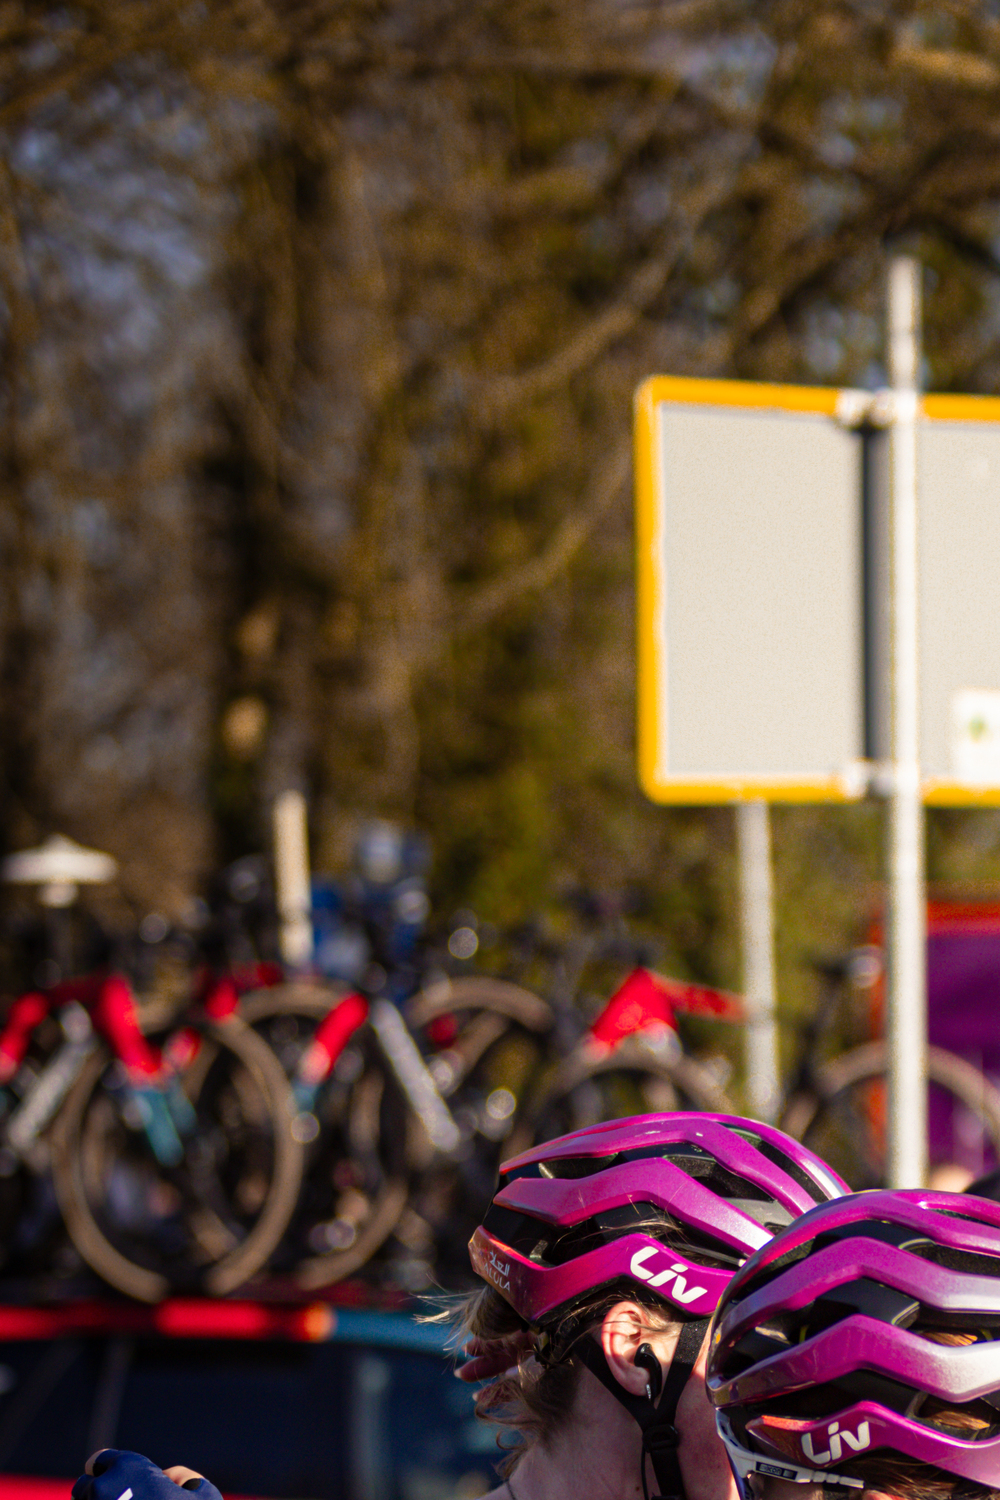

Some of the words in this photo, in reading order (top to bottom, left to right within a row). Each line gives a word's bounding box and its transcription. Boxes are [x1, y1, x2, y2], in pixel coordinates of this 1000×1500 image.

[484, 1262, 511, 1292] ALULA
[630, 1246, 708, 1304] Liv
[801, 1420, 870, 1464] Liv
